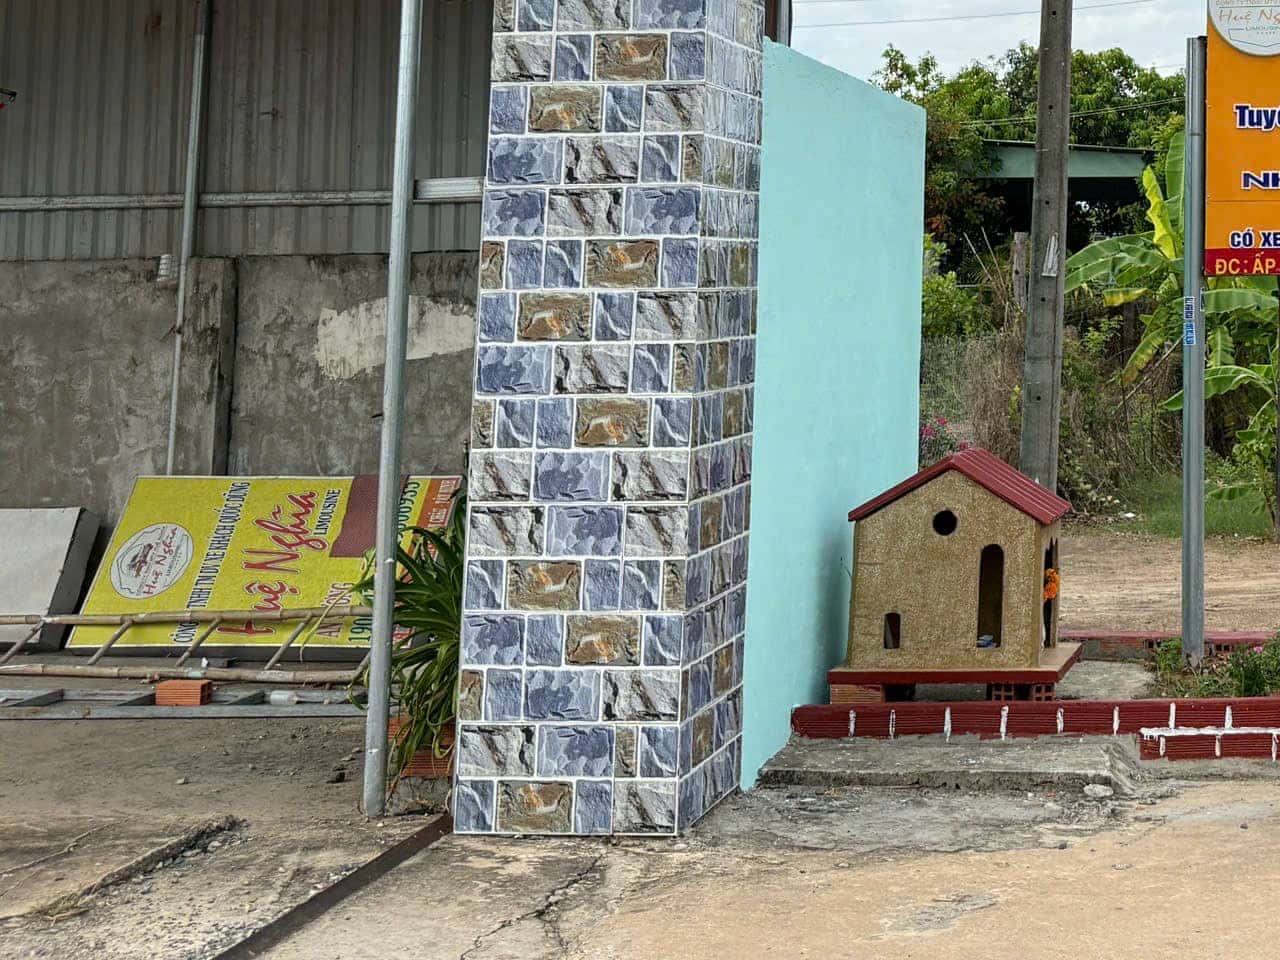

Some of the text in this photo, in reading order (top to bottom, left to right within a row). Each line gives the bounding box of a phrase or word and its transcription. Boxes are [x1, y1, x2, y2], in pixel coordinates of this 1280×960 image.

[1230, 227, 1254, 248] CÓ
[1252, 251, 1276, 274] ẤP
[314, 489, 341, 535] LIMOUSINE
[242, 491, 328, 573] Nghĩa
